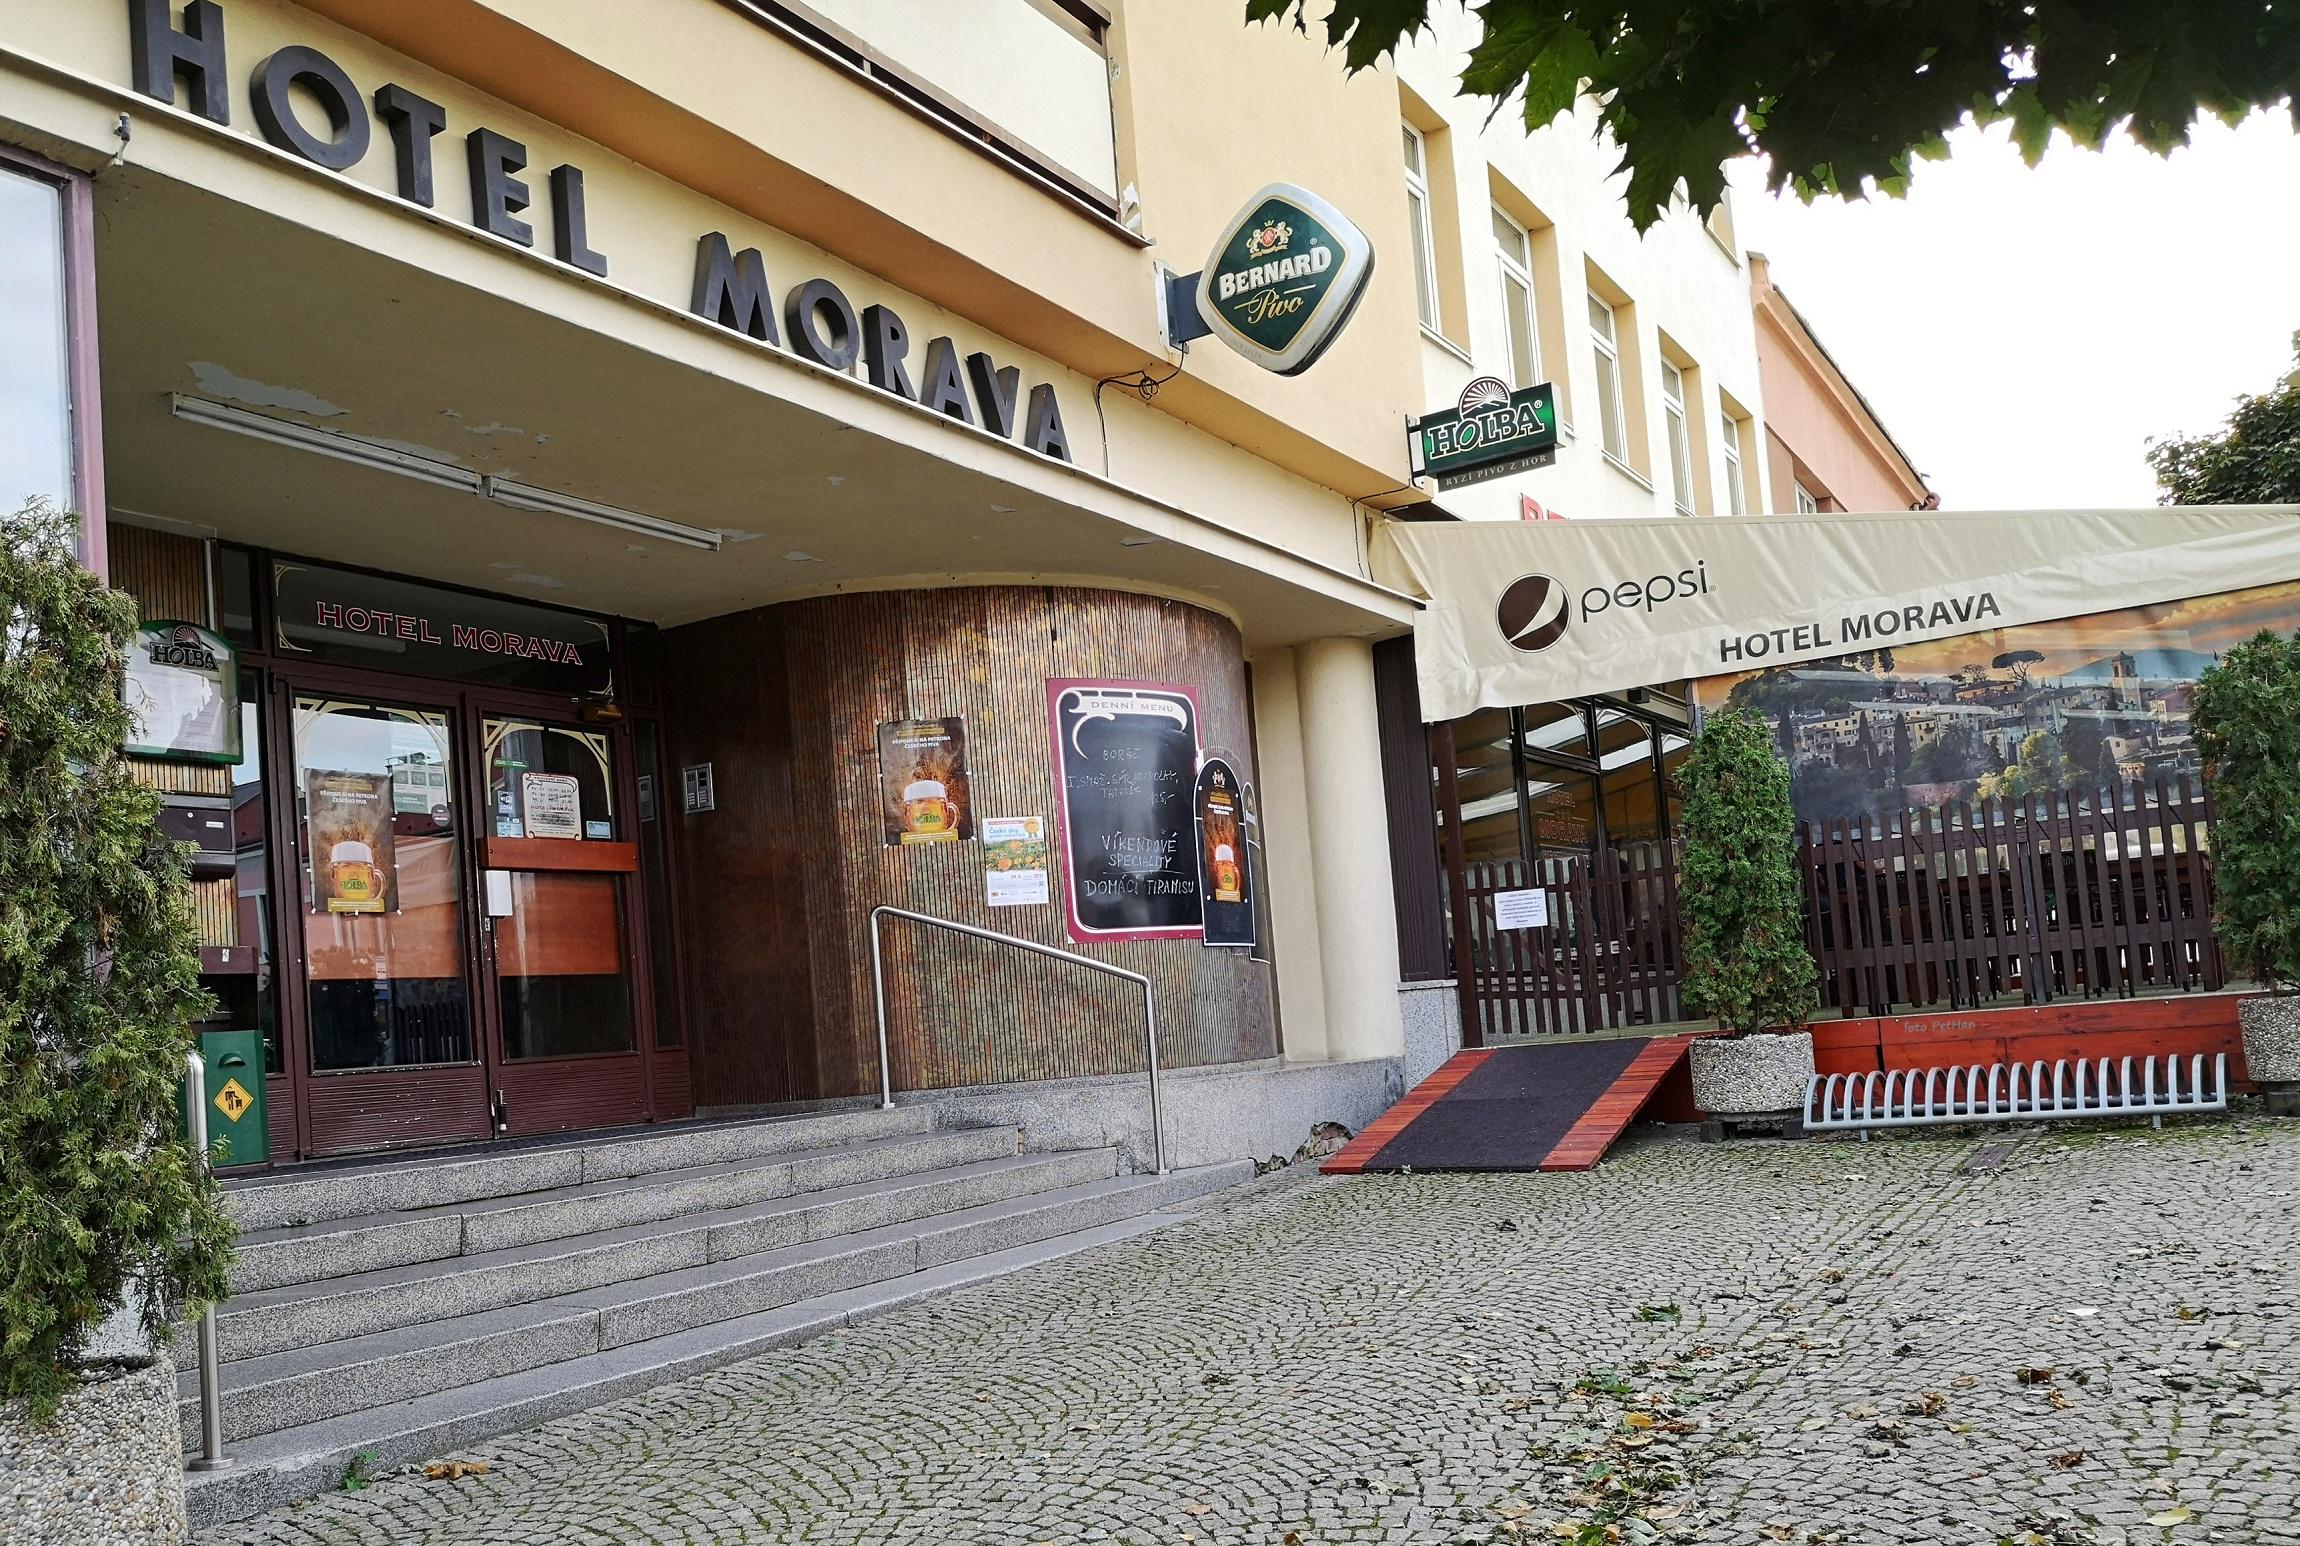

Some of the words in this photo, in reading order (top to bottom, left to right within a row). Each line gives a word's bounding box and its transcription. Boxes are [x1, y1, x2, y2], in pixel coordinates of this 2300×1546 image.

[128, 0, 608, 277] HOTEL
[690, 231, 1073, 463] MORAVA
[1218, 246, 1332, 302] BERNARD
[1246, 288, 1304, 325] Pivo
[1427, 403, 1545, 460] HOLBA
[1477, 465, 1504, 479] PIVO
[1510, 462, 1517, 470] Z
[1522, 454, 1547, 467] HOR
[1581, 560, 1708, 623] pepsi
[317, 601, 441, 645] HOTEL
[453, 624, 583, 666] MORAVA
[1720, 623, 1831, 663] HOTEL
[1841, 592, 2001, 643] MORAVA
[150, 641, 220, 672] HOLBA
[1091, 701, 1134, 710] DENNÍ
[1140, 703, 1174, 712] MENU
[1539, 818, 1588, 844] MORAVA
